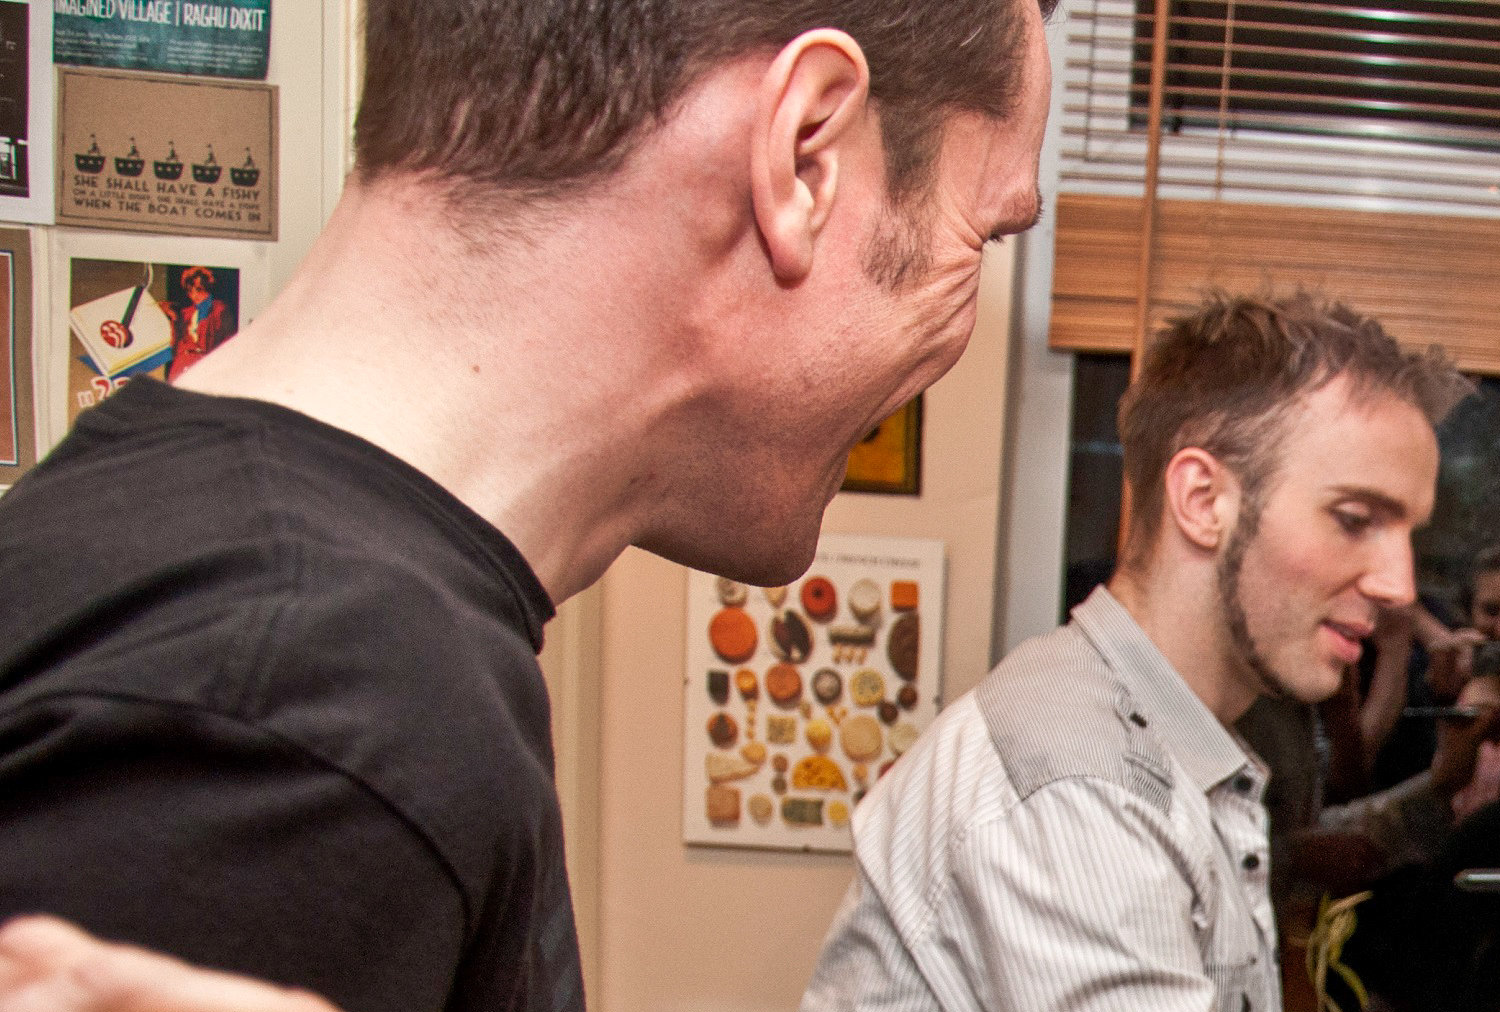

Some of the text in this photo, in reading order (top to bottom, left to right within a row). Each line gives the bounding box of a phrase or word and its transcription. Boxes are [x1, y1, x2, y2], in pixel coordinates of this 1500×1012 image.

[118, 0, 171, 24] VILLAGE
[183, 2, 228, 29] RAGHU
[230, 6, 266, 32] DIXIT
[73, 174, 260, 201] SHE SHALL HAVE A FISHY
[73, 198, 261, 222] WHEN THE BOAT COMES IN
